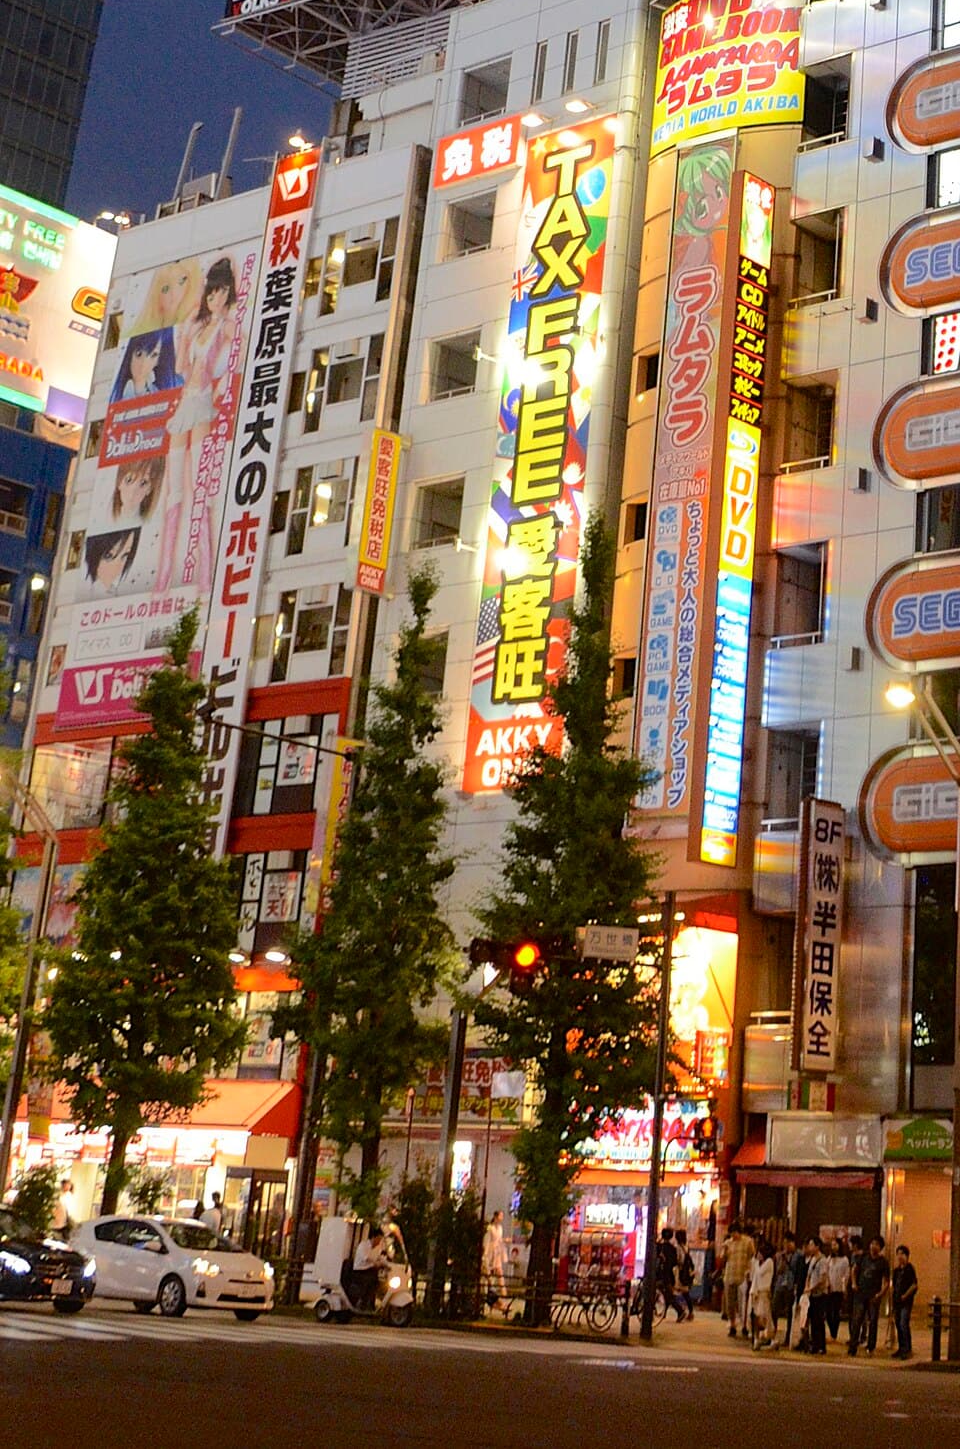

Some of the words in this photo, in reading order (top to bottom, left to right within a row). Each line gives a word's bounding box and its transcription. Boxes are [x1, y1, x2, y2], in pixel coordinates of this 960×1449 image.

[667, 65, 776, 115] ラムタラ
[691, 101, 737, 125] WORLD
[744, 95, 799, 113] AKIBA
[442, 122, 512, 182] 免税
[24, 220, 66, 249] FREE
[531, 141, 594, 299] TAX
[741, 258, 768, 288] ゲーム
[741, 283, 764, 308] CD
[736, 303, 766, 332] アイドル
[735, 326, 766, 354] アニメ
[662, 264, 718, 449] ラムタラ
[734, 351, 763, 379] コミック
[512, 294, 581, 507] FREE
[733, 375, 761, 399] ホビー
[658, 524, 677, 535] DVD
[724, 467, 754, 566] DVD
[650, 616, 674, 627] GAME
[647, 661, 671, 673] GAME
[668, 501, 702, 808] ちょっと大人の総合メディアショップ
[643, 706, 668, 717] BOOK
[475, 723, 553, 756] AKKY
[905, 1137, 954, 1150] ペッパーラン
